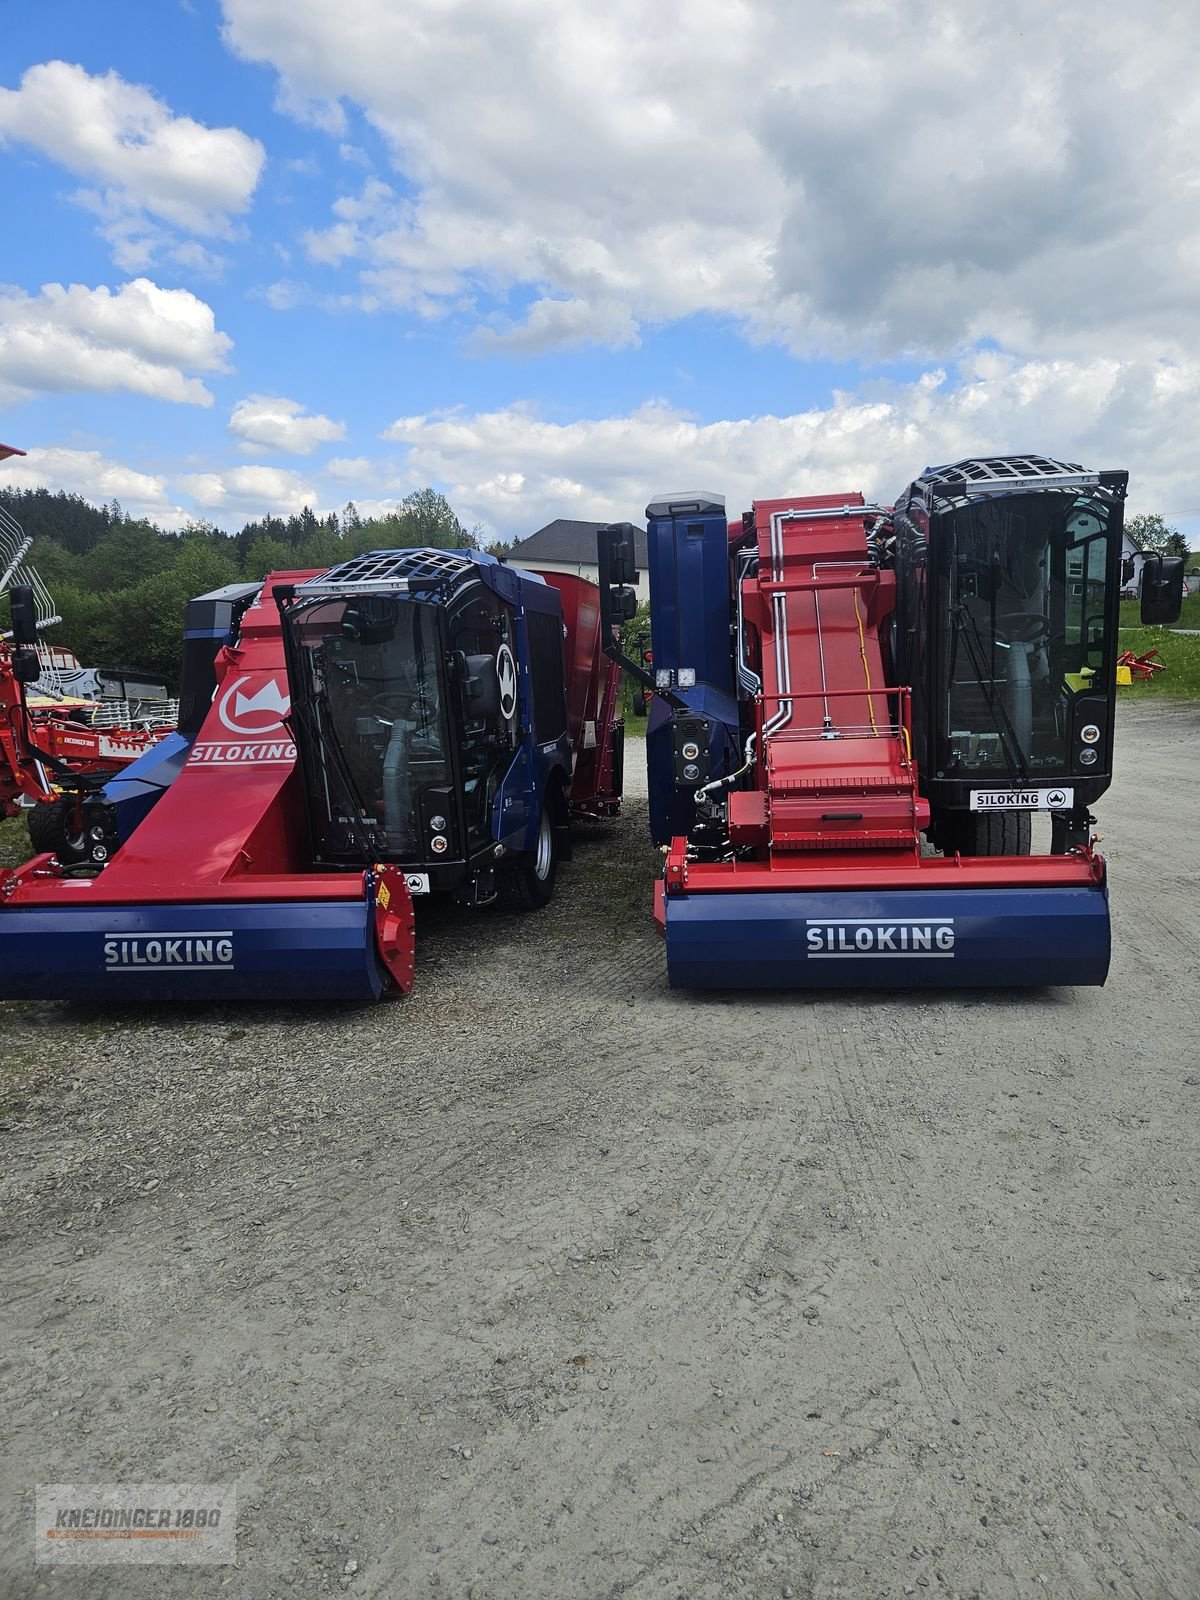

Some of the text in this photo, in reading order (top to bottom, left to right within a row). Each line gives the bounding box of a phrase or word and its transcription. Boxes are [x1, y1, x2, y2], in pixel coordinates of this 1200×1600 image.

[189, 744, 298, 762] SILOKING
[977, 794, 1039, 805] SILOKING
[806, 927, 955, 950] SILOKING
[104, 939, 233, 963] SILOKING
